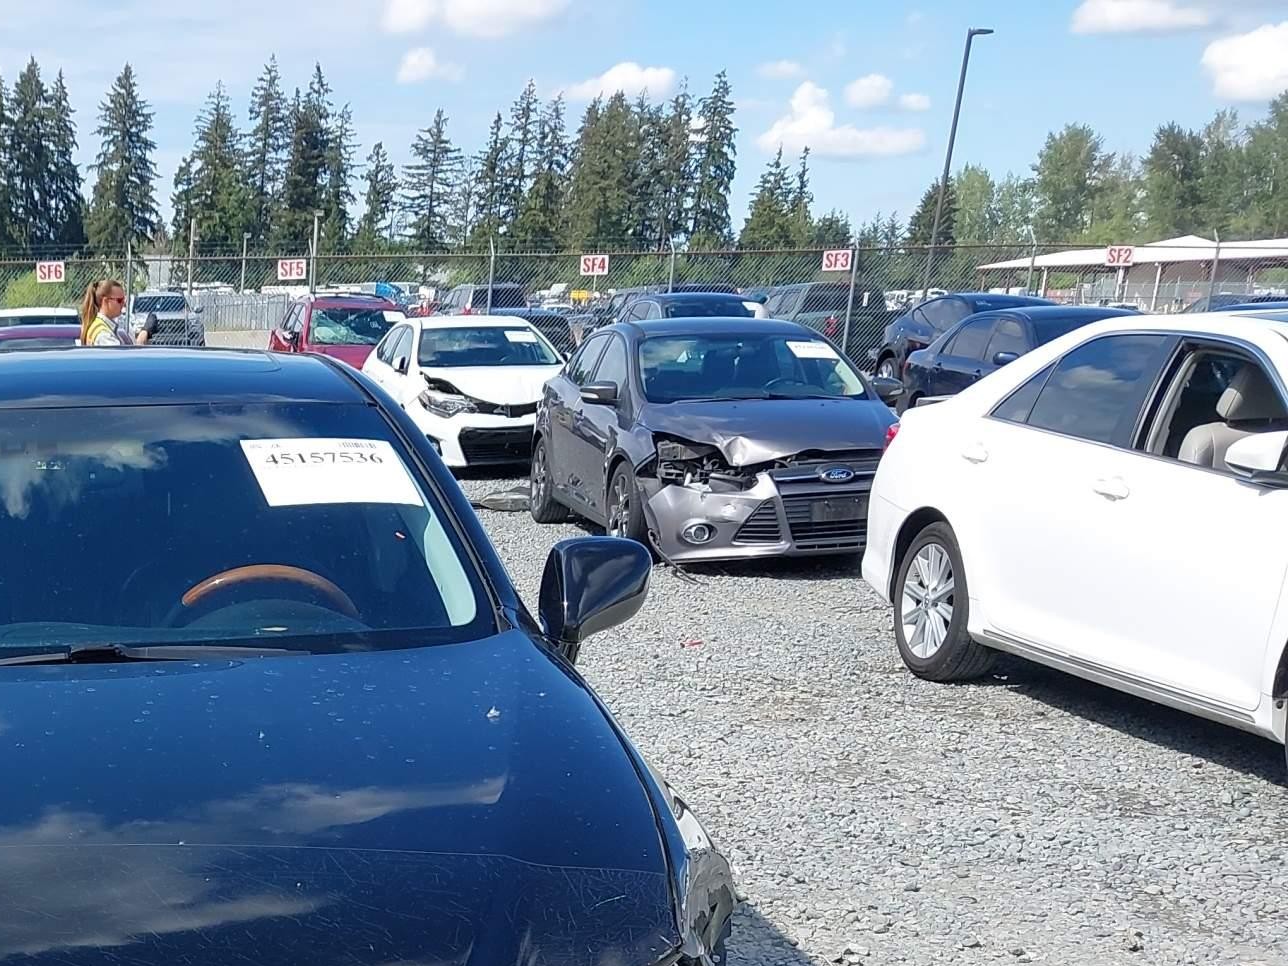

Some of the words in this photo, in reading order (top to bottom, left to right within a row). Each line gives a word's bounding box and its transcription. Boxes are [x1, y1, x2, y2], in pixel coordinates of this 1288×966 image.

[825, 252, 849, 268] SF3
[1108, 247, 1132, 264] SF2
[39, 264, 62, 280] SF6
[280, 261, 304, 277] SF5
[583, 257, 606, 273] SF4
[265, 452, 384, 465] 45157536
